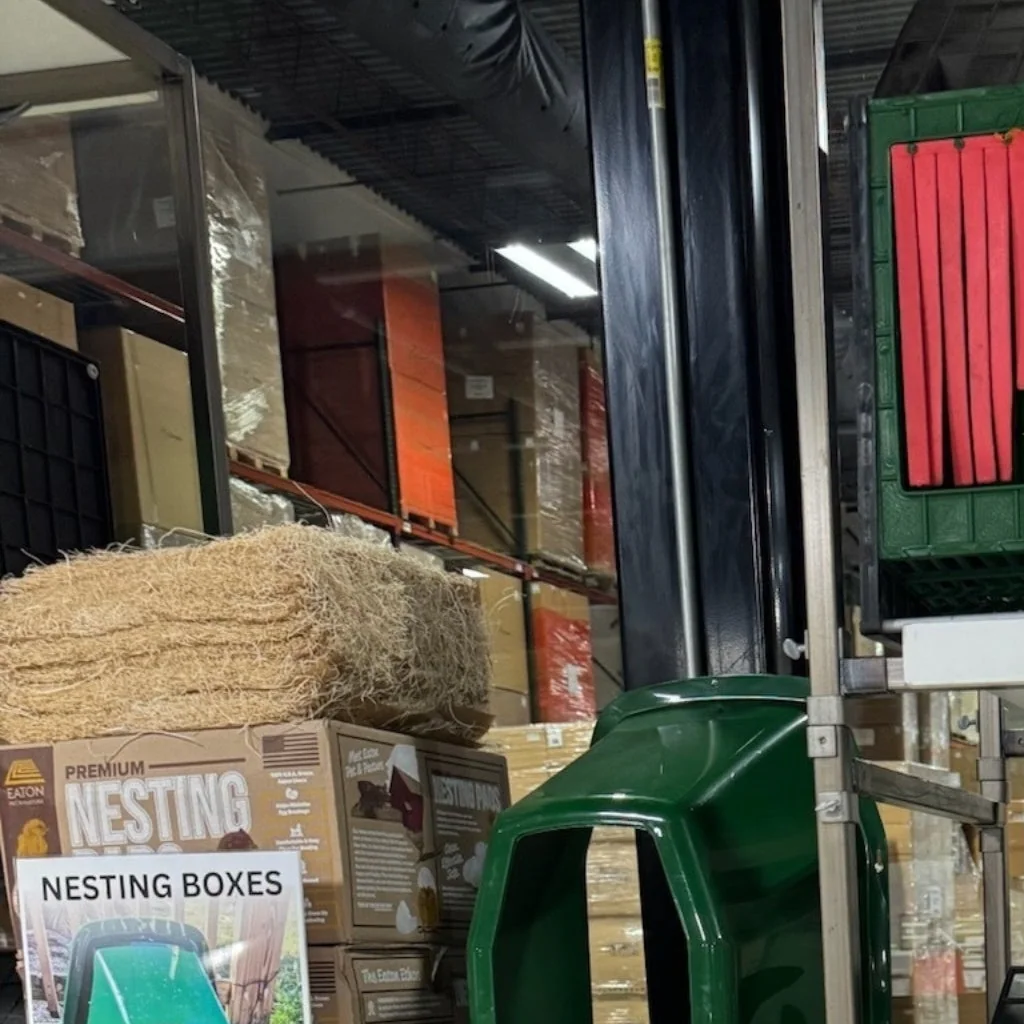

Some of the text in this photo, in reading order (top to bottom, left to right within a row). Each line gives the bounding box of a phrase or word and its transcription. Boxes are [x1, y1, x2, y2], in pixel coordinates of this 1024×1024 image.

[65, 760, 145, 778] PREMIUM
[7, 786, 45, 799] EATON
[64, 771, 251, 847] NESTING
[41, 870, 283, 901] NESTING BOXES
